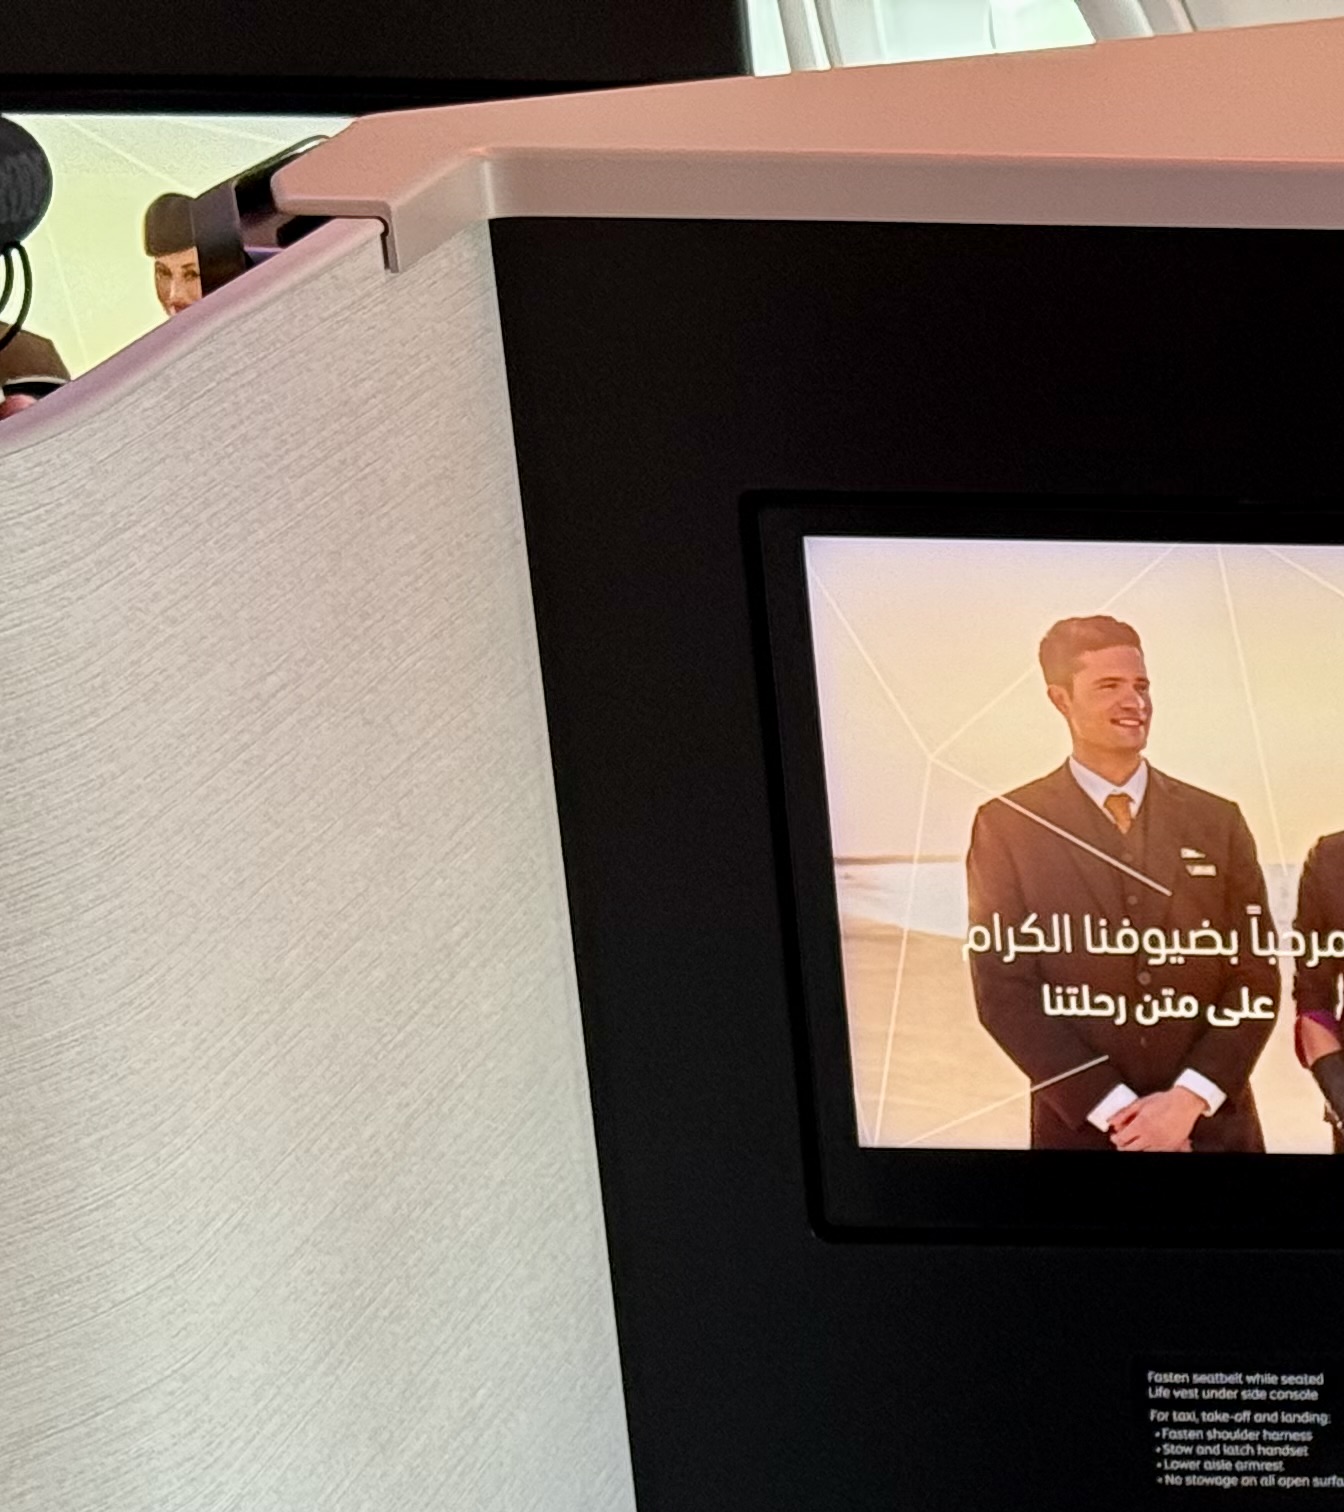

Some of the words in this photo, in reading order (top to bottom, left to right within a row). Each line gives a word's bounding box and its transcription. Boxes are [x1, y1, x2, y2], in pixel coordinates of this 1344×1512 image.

[962, 911, 1073, 963] الكرام
[1084, 914, 1240, 966] بضيوفنا
[1042, 983, 1127, 1023] رحلتنا
[1135, 988, 1199, 1025] متن
[1148, 1371, 1190, 1383] Fasten
[1193, 1373, 1243, 1384] seatbelt
[1246, 1373, 1279, 1384] while
[1281, 1373, 1324, 1385] seated
[1149, 1386, 1170, 1398] Life
[1173, 1388, 1199, 1399] vest
[1202, 1388, 1238, 1399] under
[1241, 1389, 1267, 1400] side
[1269, 1389, 1318, 1400] console
[1150, 1410, 1169, 1421] For
[1201, 1411, 1251, 1422] take-off
[1254, 1412, 1278, 1423] and
[1162, 1428, 1204, 1440] Fasten
[1206, 1428, 1260, 1440] shoulder
[1263, 1429, 1313, 1441] harness
[1163, 1443, 1193, 1455] Stow
[1196, 1444, 1220, 1455] and
[1223, 1444, 1255, 1456] latch
[1257, 1444, 1308, 1456] handset
[1164, 1460, 1201, 1470] Lower
[1204, 1460, 1233, 1470] aisle
[1235, 1461, 1283, 1471] armrest
[1165, 1474, 1183, 1485] No
[1185, 1475, 1238, 1488] stowage
[1241, 1476, 1257, 1486] on
[1260, 1475, 1275, 1486] all
[1278, 1477, 1310, 1488] open
